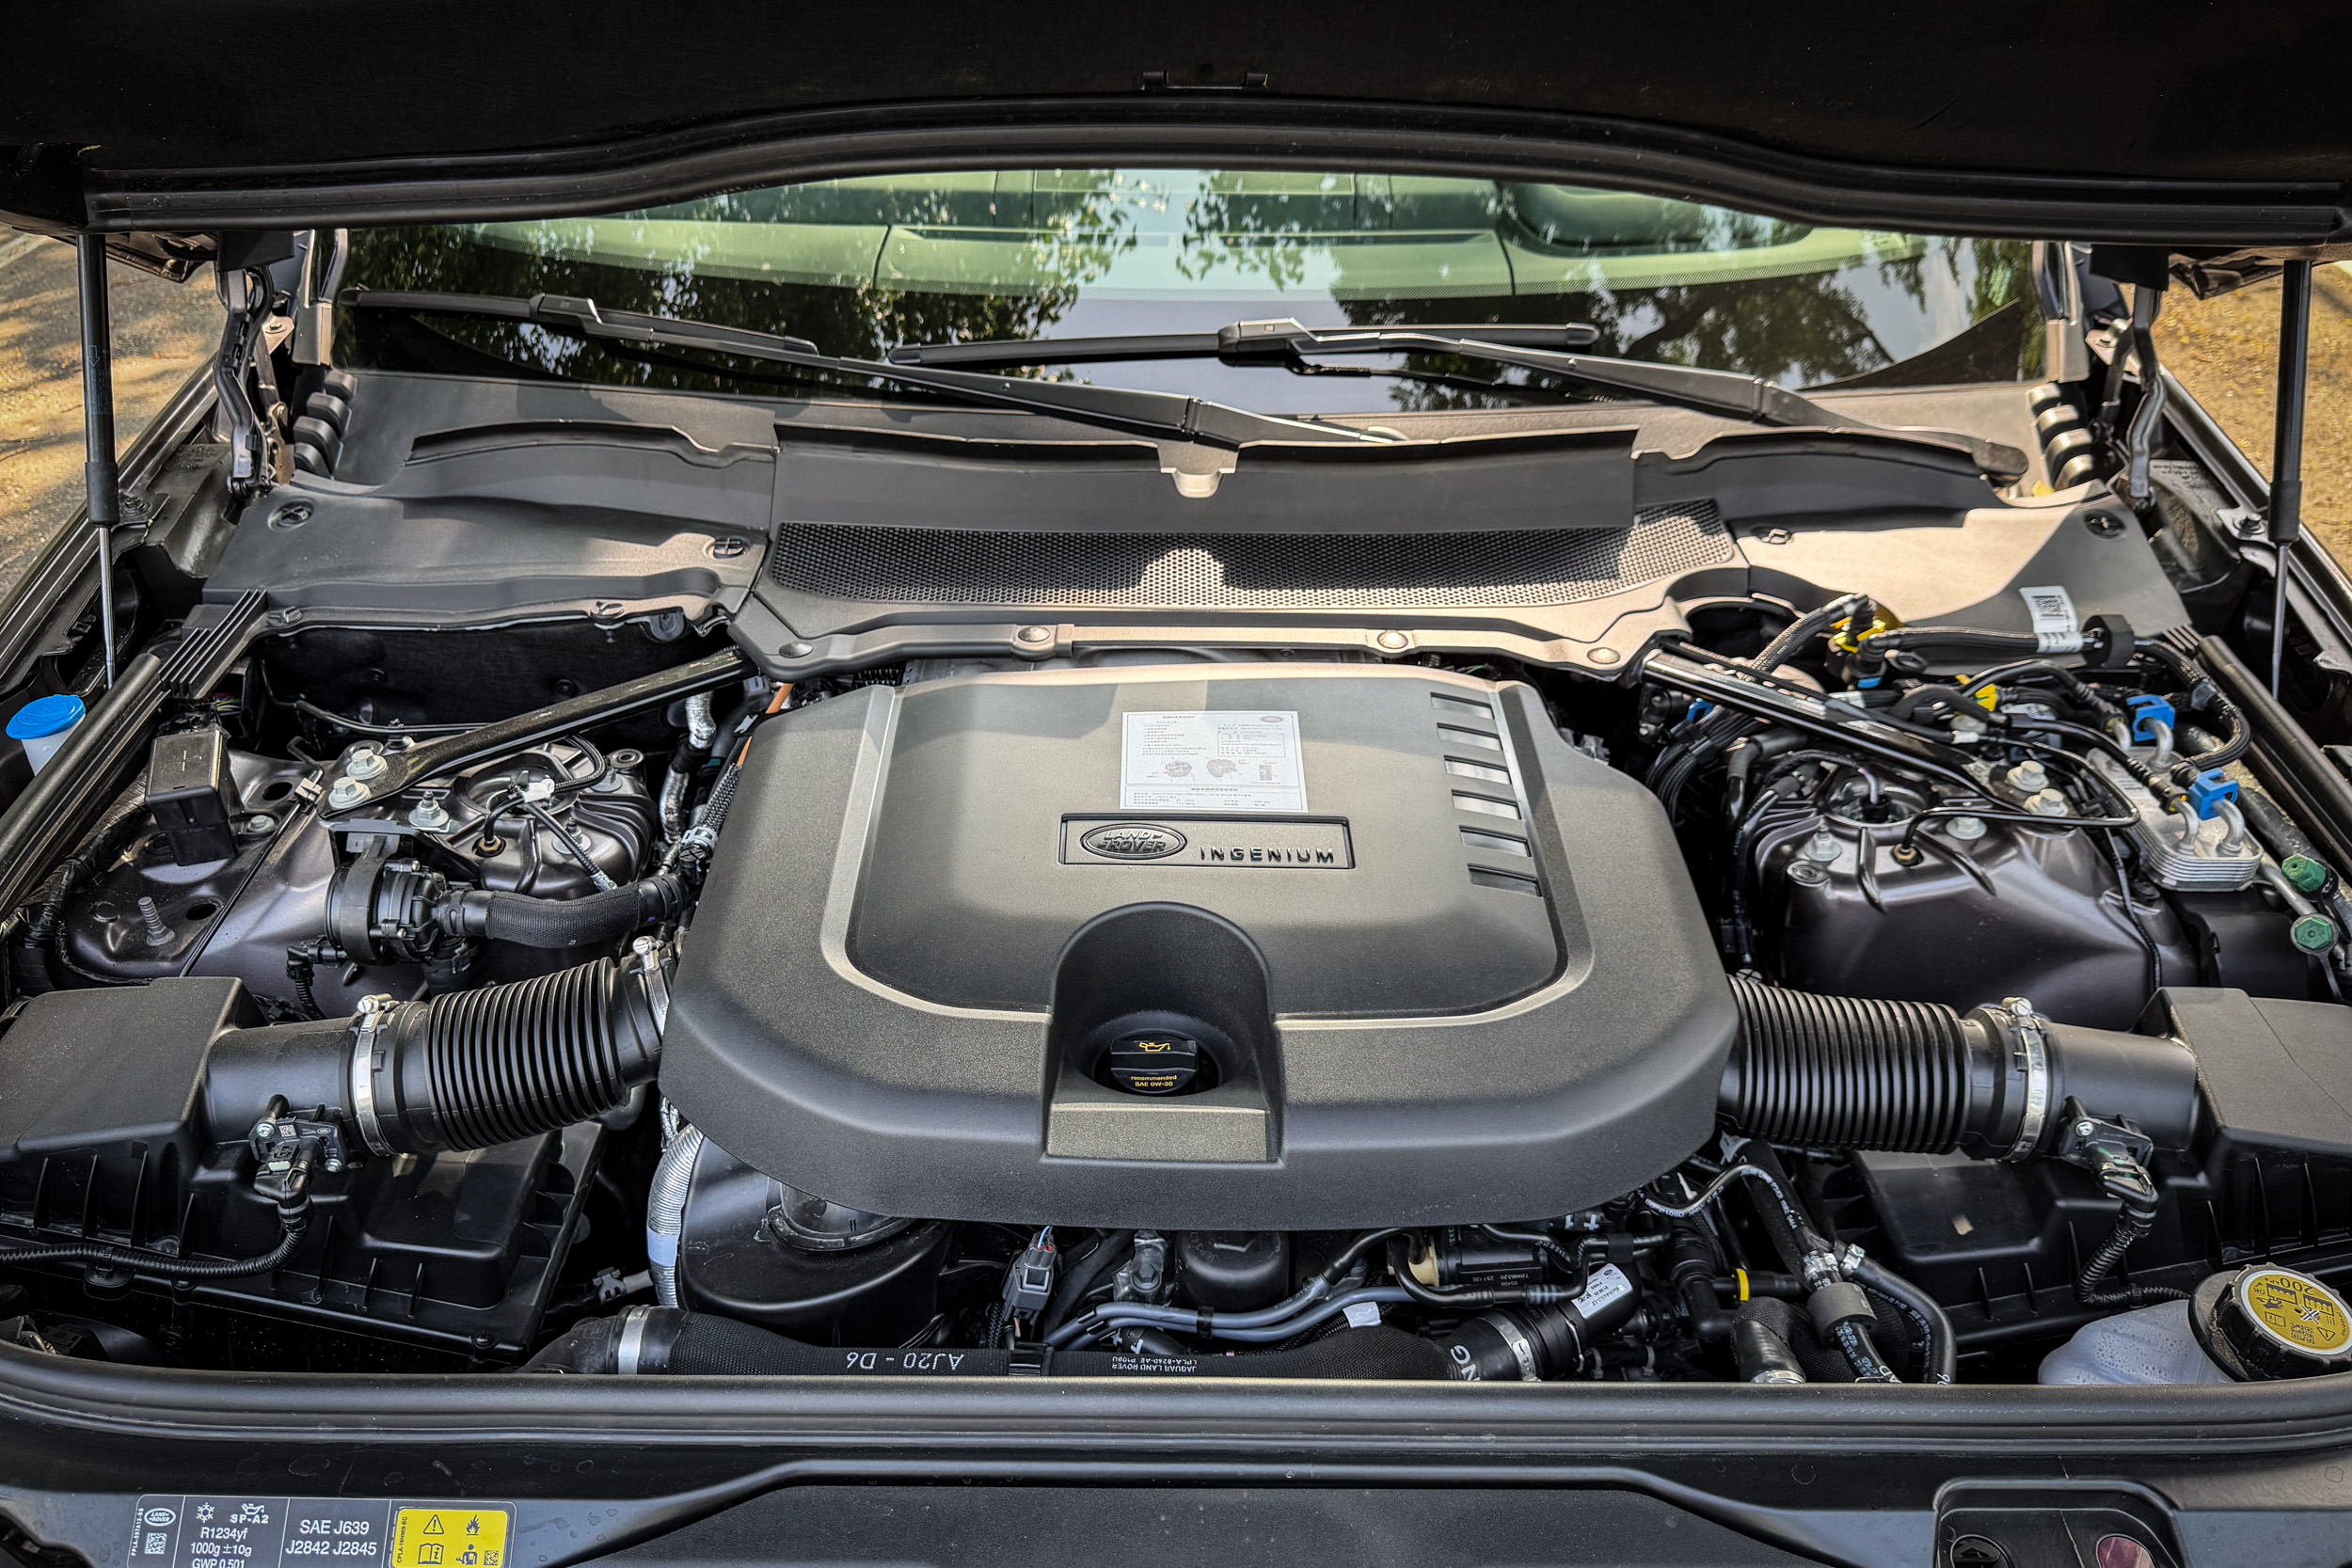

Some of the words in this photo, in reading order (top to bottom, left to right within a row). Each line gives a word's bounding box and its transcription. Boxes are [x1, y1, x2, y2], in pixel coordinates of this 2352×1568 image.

[1104, 830, 1154, 840] LAND
[1104, 840, 1168, 853] ROVER
[1200, 846, 1335, 864] INGENIUM
[2280, 1277, 2314, 1296] 200
[846, 1352, 878, 1370] D6
[902, 1352, 965, 1370] AJ20
[1111, 1362, 1139, 1370] ROVER
[1139, 1363, 1163, 1371] LAND
[1164, 1364, 1197, 1372] JAGUAR
[230, 1513, 270, 1524] SP-A2
[200, 1527, 248, 1542] R1234yf
[299, 1519, 332, 1535] SAE
[333, 1520, 371, 1535] J639
[190, 1542, 221, 1557] 1000g
[222, 1544, 252, 1558] ±10g
[285, 1540, 330, 1555] J2842
[332, 1541, 378, 1556] J2845
[192, 1558, 217, 1568] GWP
[219, 1559, 246, 1568] 0.501
